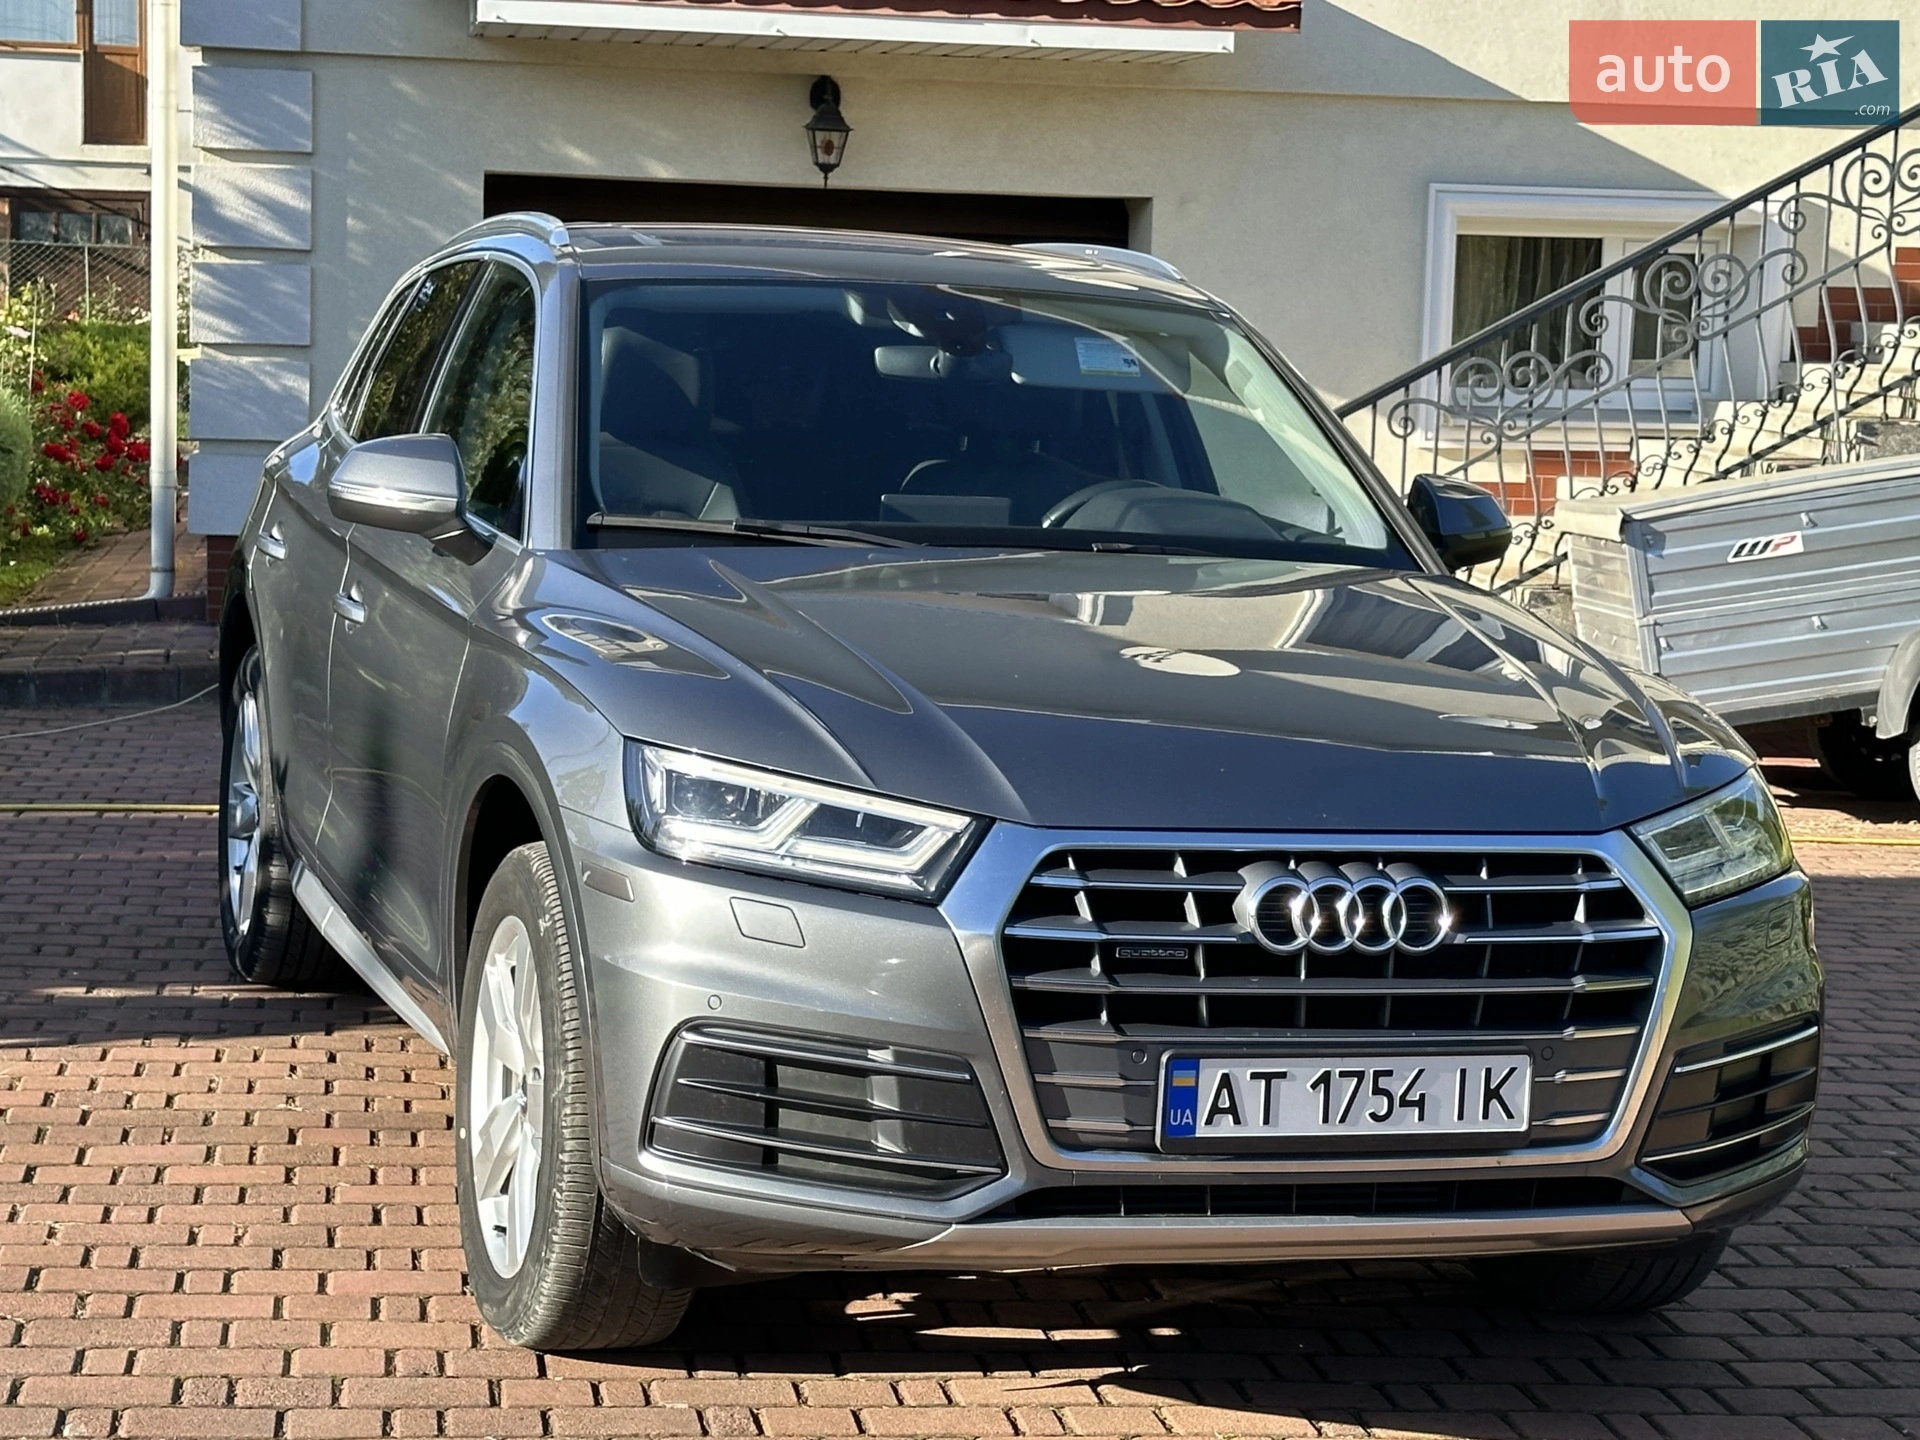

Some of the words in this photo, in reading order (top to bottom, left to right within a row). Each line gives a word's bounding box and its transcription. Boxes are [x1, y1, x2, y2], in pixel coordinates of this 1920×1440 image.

[1120, 949, 1185, 957] quattro
[1203, 1070, 1288, 1126] AT
[1307, 1068, 1426, 1124] 1754
[1454, 1066, 1518, 1121] IK
[1170, 1109, 1193, 1125] UA
